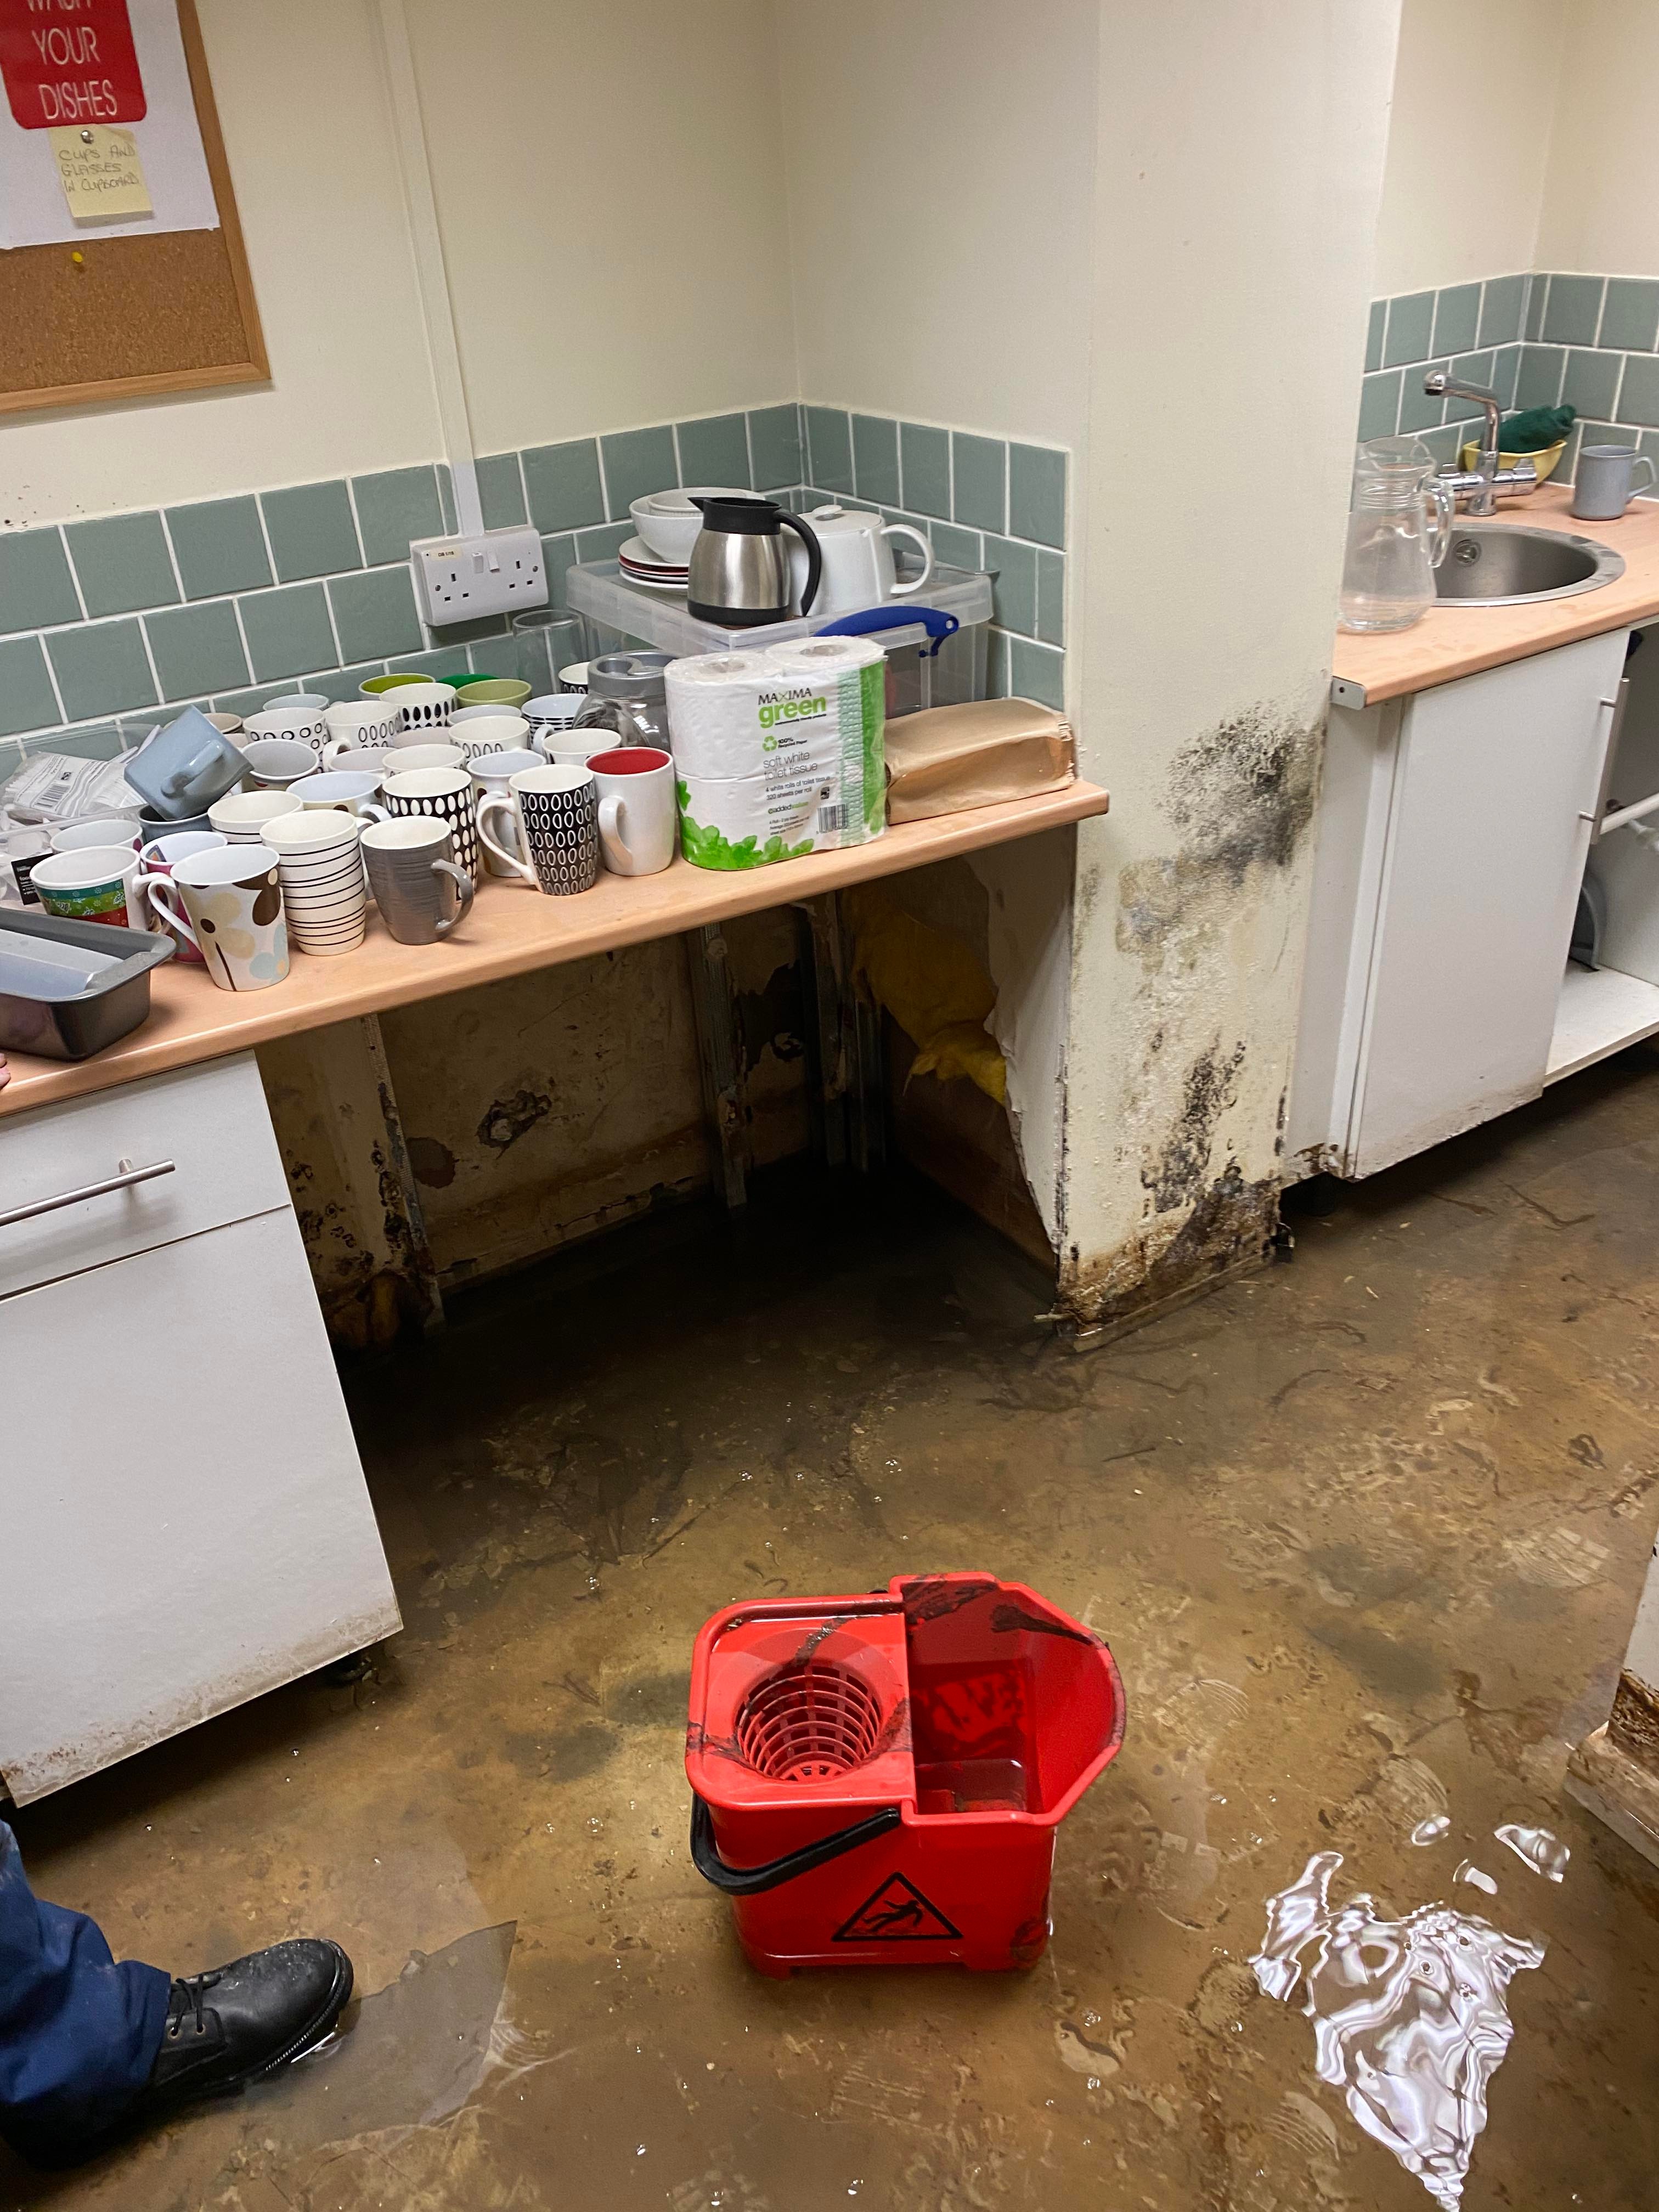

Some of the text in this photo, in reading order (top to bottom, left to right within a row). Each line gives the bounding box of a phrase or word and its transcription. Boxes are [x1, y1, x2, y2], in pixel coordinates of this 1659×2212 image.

[32, 27, 101, 65] YOUR
[38, 79, 117, 120] DISHES
[59, 148, 100, 162] CUPS
[61, 162, 122, 177] GLASSES
[82, 172, 139, 192] CUPBOARD
[758, 687, 812, 705] MAXIMA
[759, 697, 826, 729] green
[763, 752, 810, 769] soft white
[764, 763, 817, 781] toilet tissue
[777, 791, 794, 799] sheets
